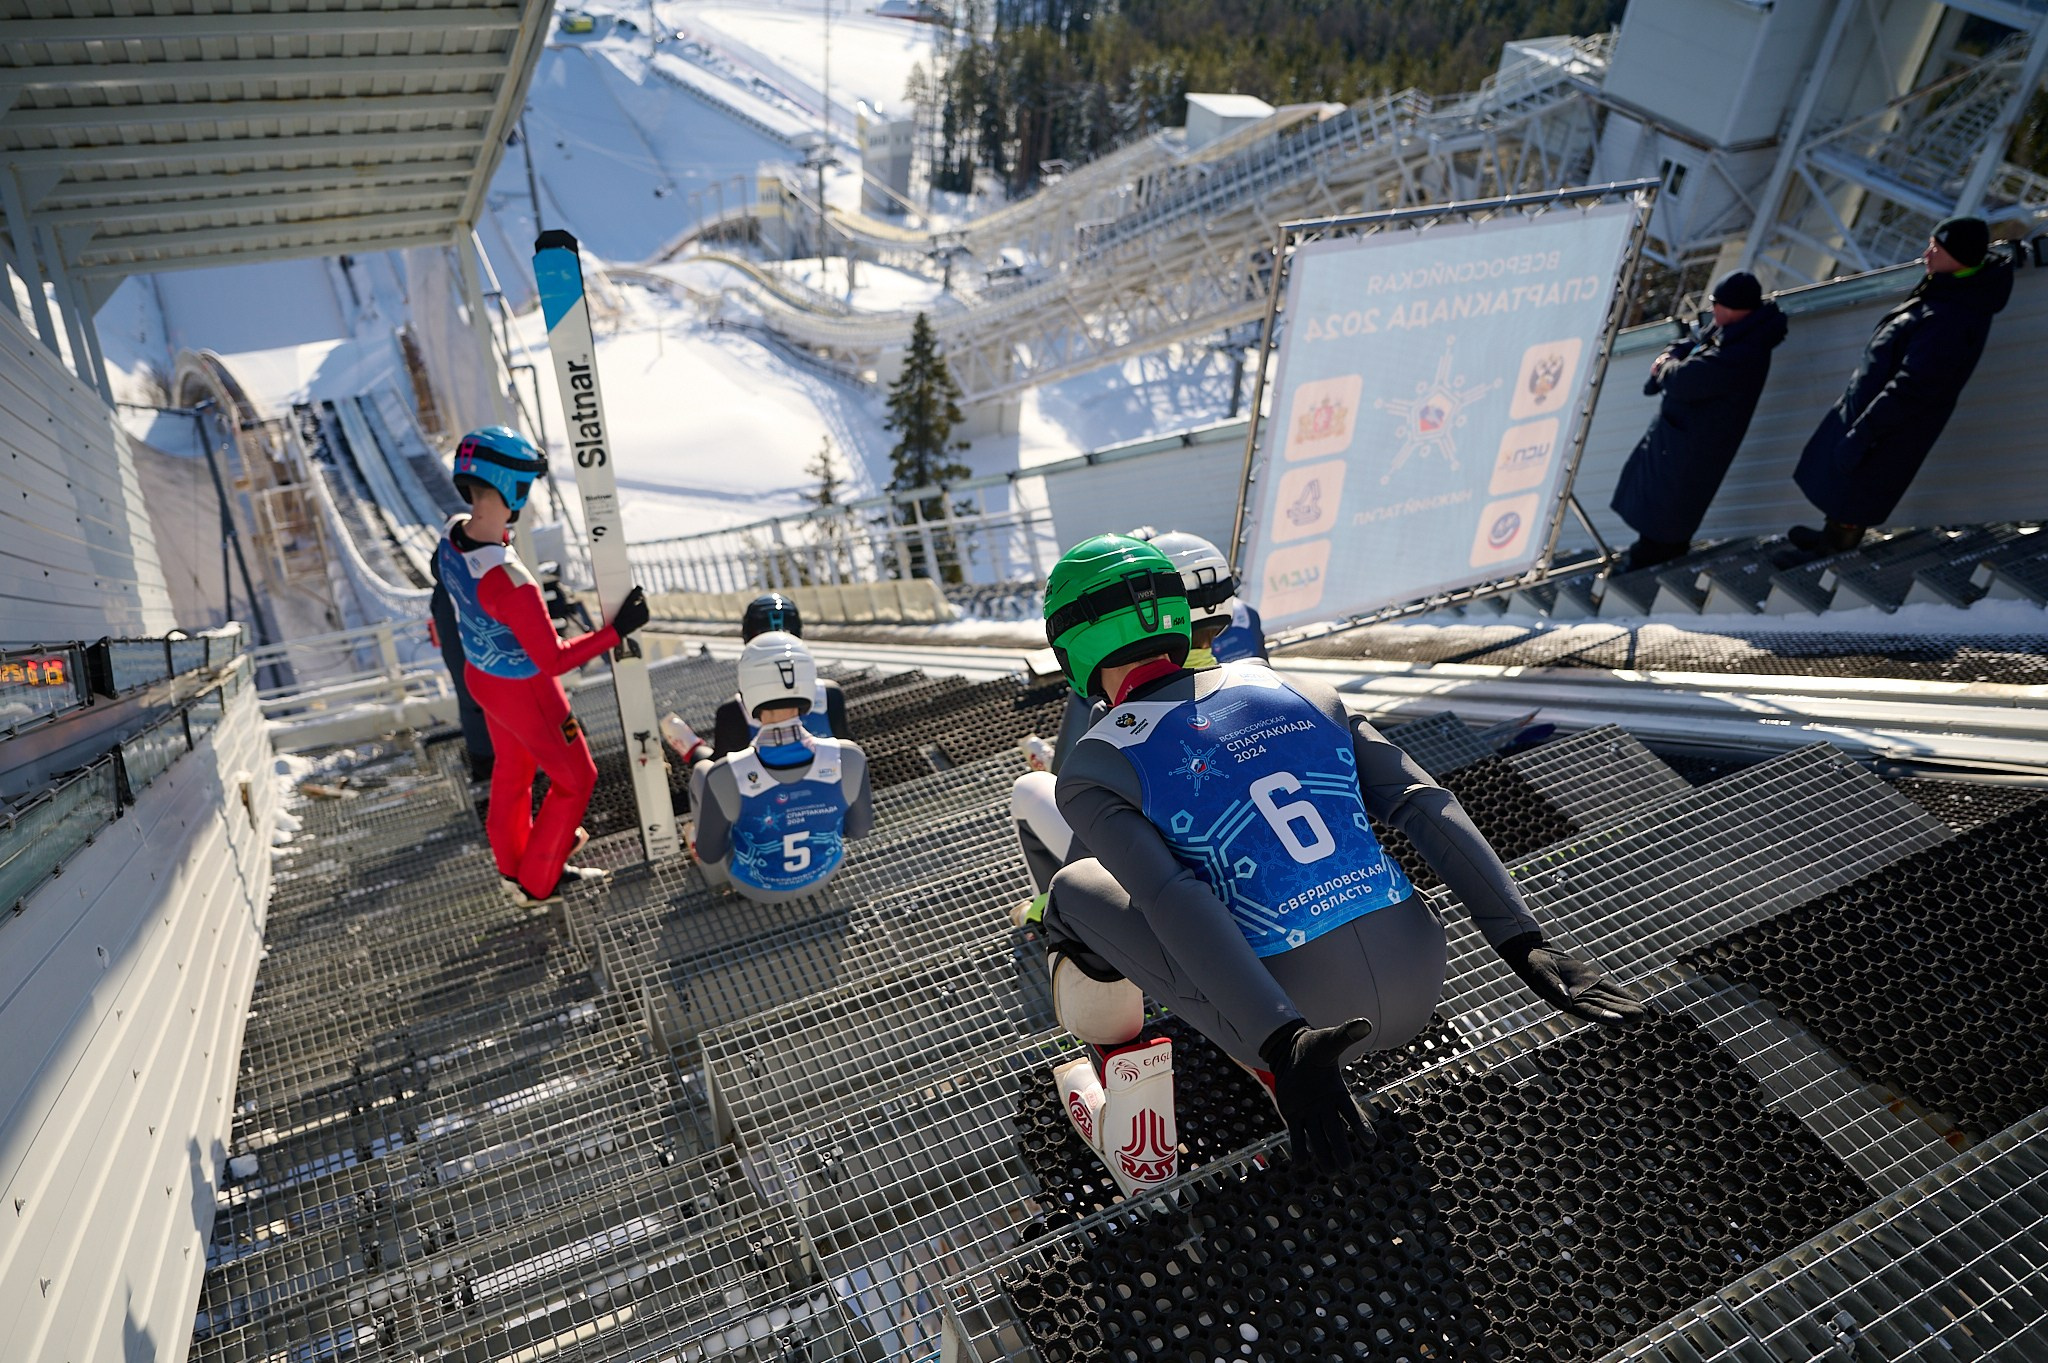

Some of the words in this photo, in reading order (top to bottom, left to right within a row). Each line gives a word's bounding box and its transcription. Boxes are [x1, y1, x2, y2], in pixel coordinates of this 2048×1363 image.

[568, 360, 607, 469] Slatnar
[1218, 715, 1287, 743] ВСЕРОССИЙСКАЯ
[1226, 719, 1317, 752] СПАРТАКИАДА
[1233, 744, 1268, 764] 2024
[786, 805, 838, 819] СПАРТАКИАДА
[786, 817, 806, 826] 2024
[1249, 771, 1336, 865] 6
[783, 830, 811, 873] 5
[1278, 863, 1385, 916] СВЕРДЛОВСКАЯ
[1310, 884, 1374, 917] ОБЛАСТЬ
